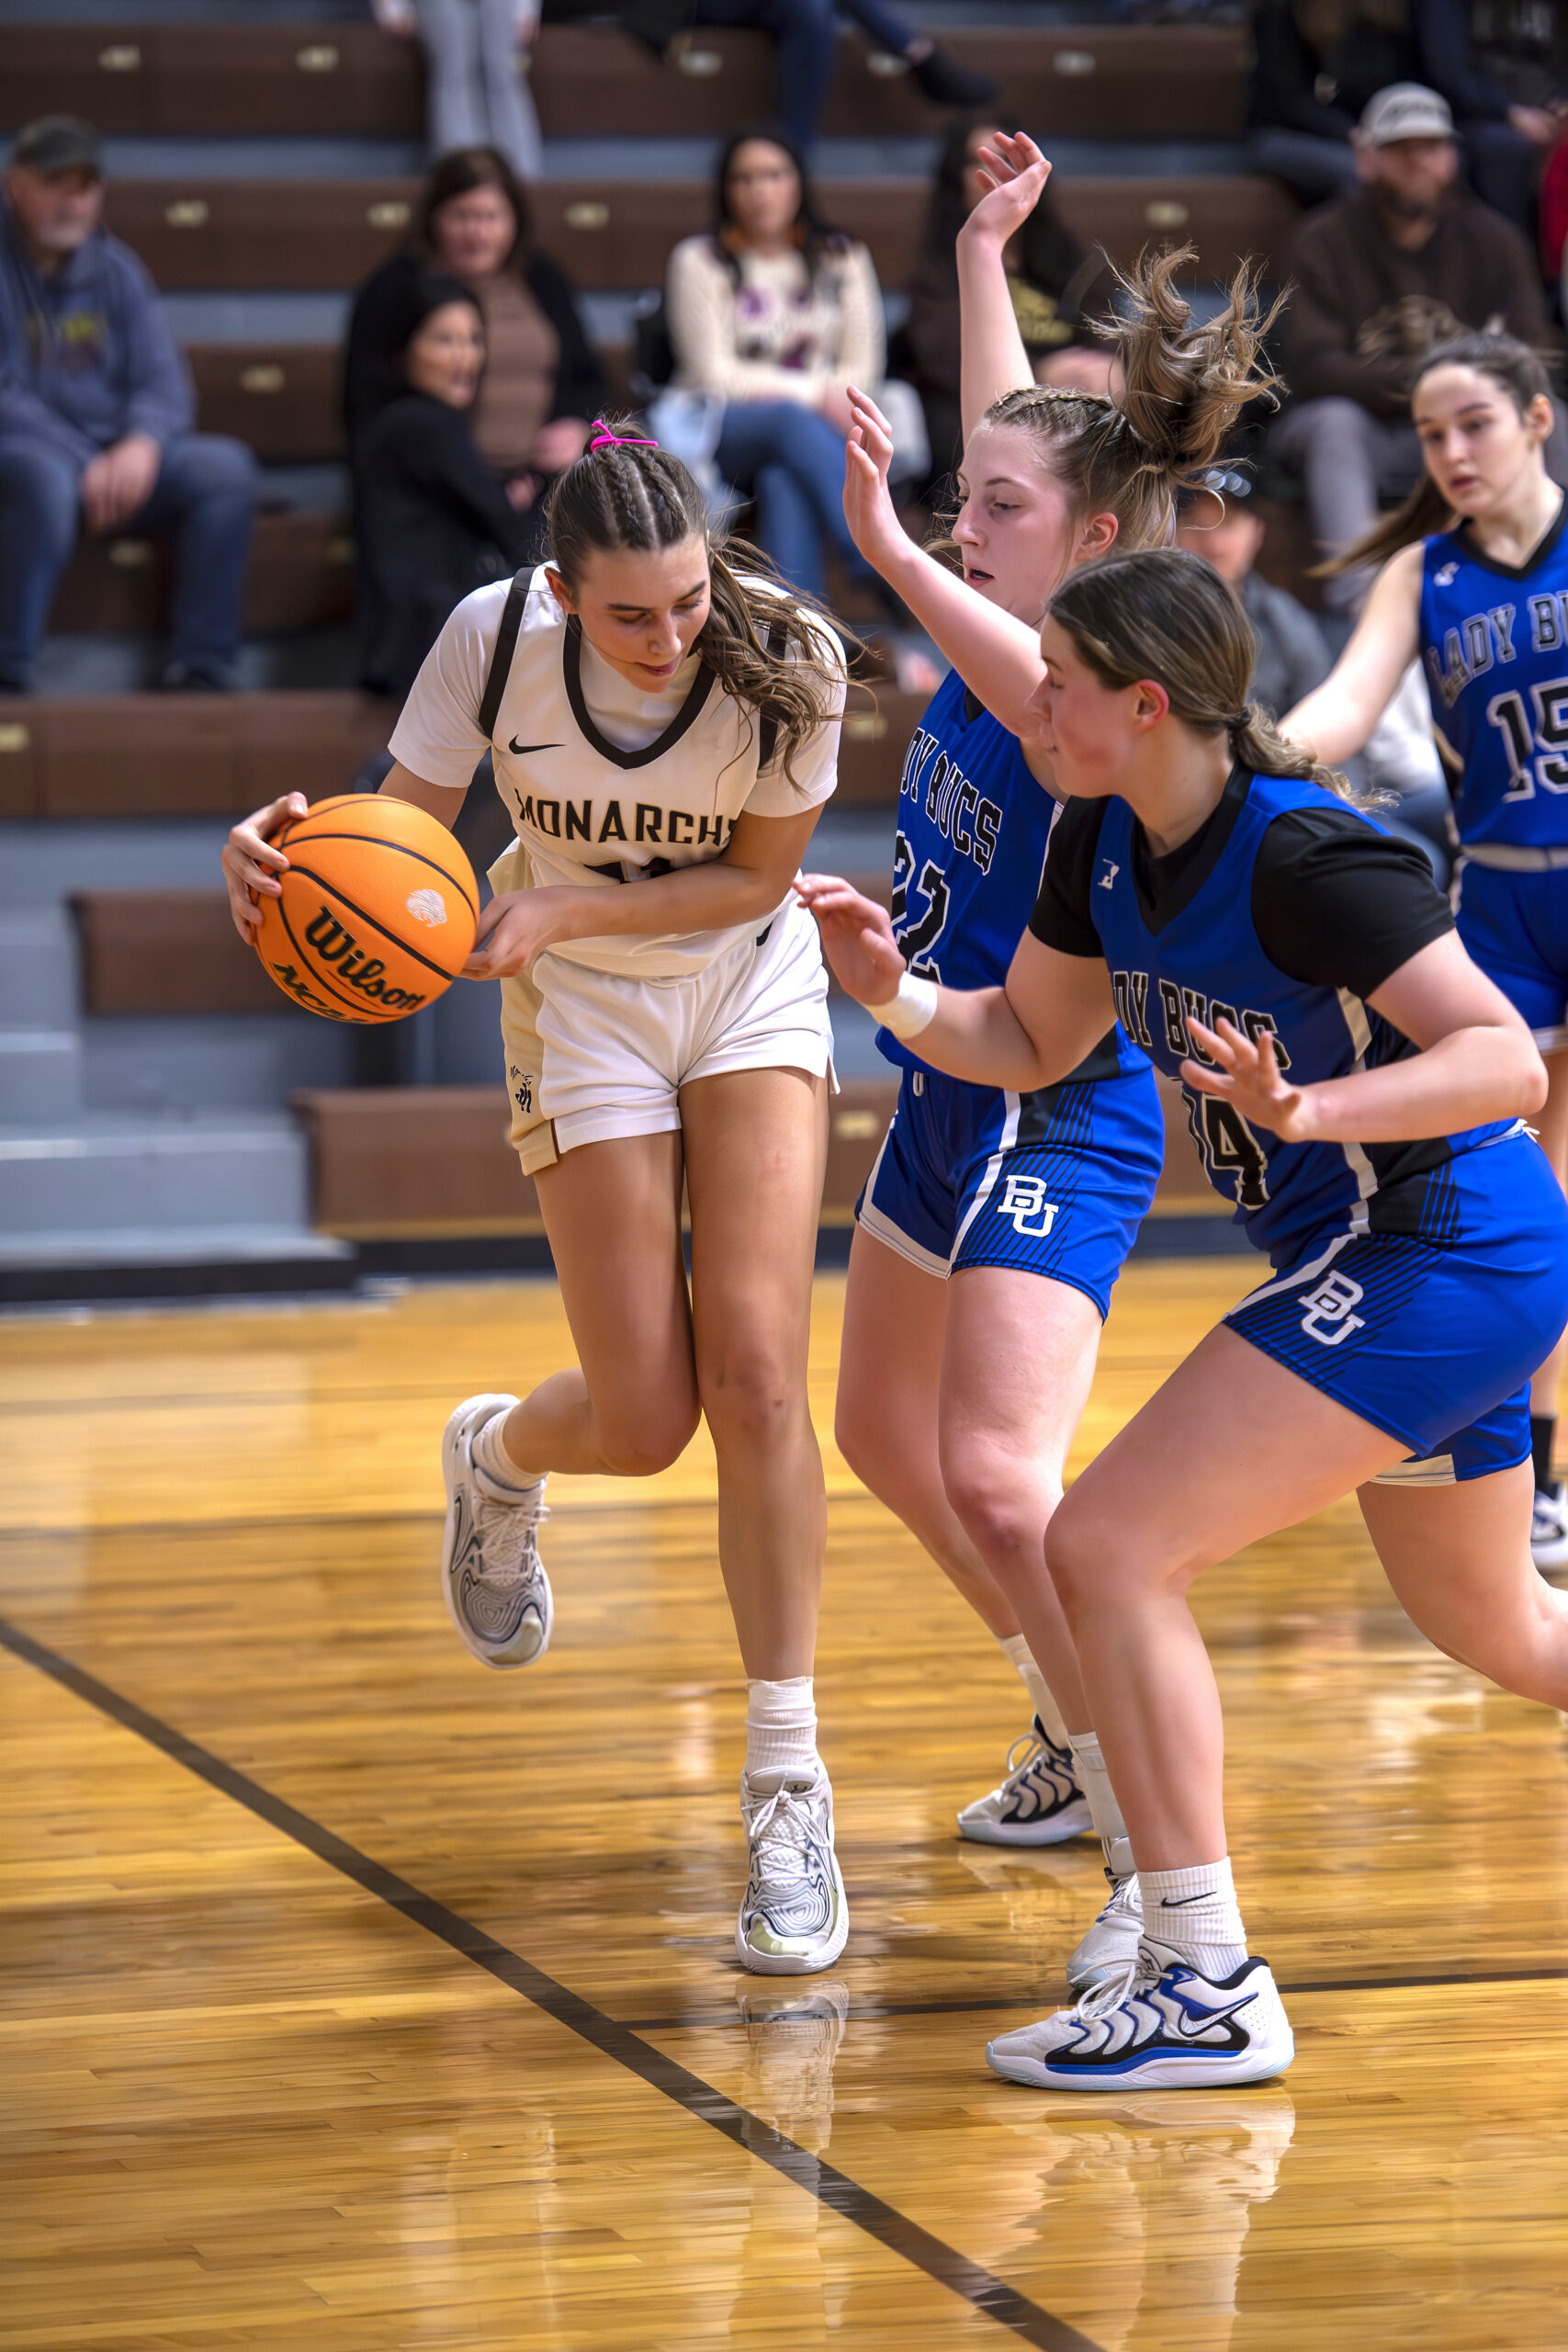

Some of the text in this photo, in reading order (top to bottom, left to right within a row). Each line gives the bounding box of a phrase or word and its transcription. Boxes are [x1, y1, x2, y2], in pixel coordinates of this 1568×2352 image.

[1527, 590, 1568, 653] B
[1486, 676, 1568, 804] 15
[926, 750, 1003, 876] BUCS
[305, 904, 427, 1011] Wilson
